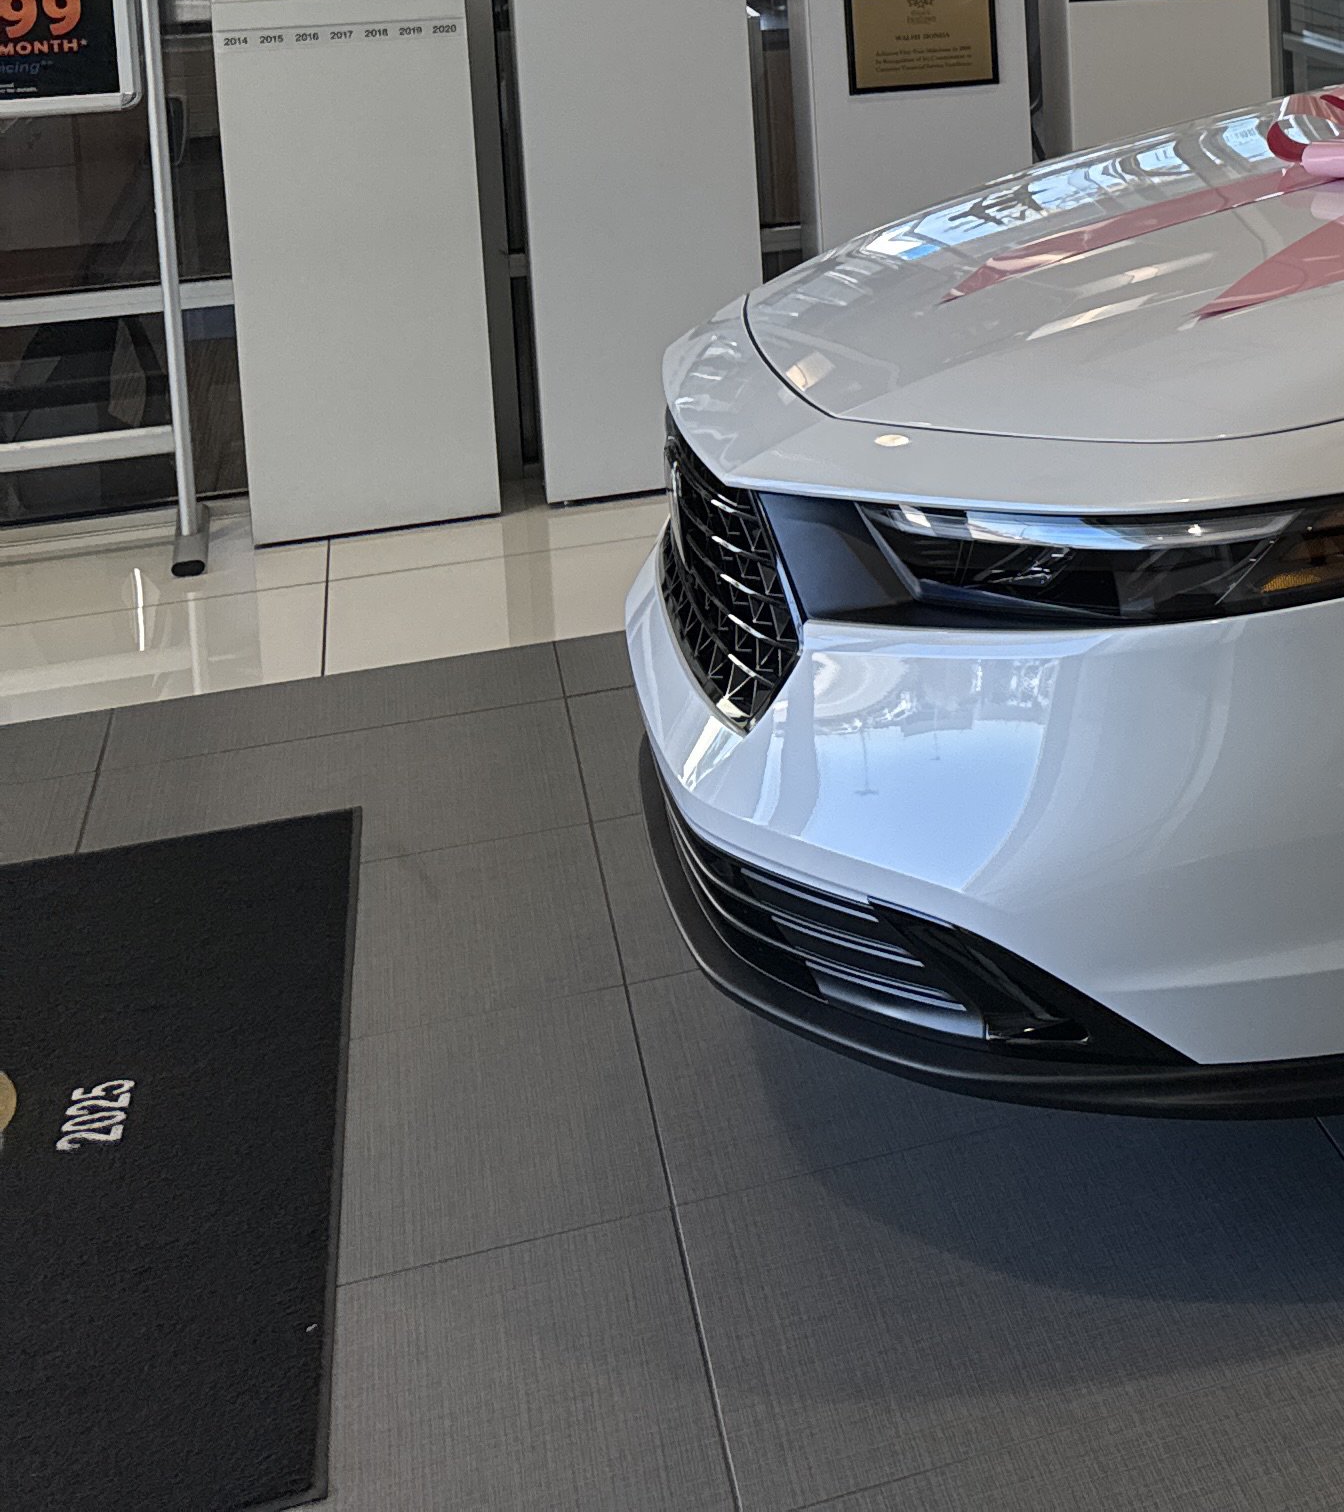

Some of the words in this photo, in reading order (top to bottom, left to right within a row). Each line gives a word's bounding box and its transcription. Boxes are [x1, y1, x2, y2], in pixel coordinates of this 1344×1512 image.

[224, 37, 248, 46] 2014
[260, 35, 284, 44] 2015
[295, 33, 319, 42] 2016
[330, 31, 353, 40] 2017
[432, 24, 456, 34] 2020
[56, 1079, 137, 1150] 2025
